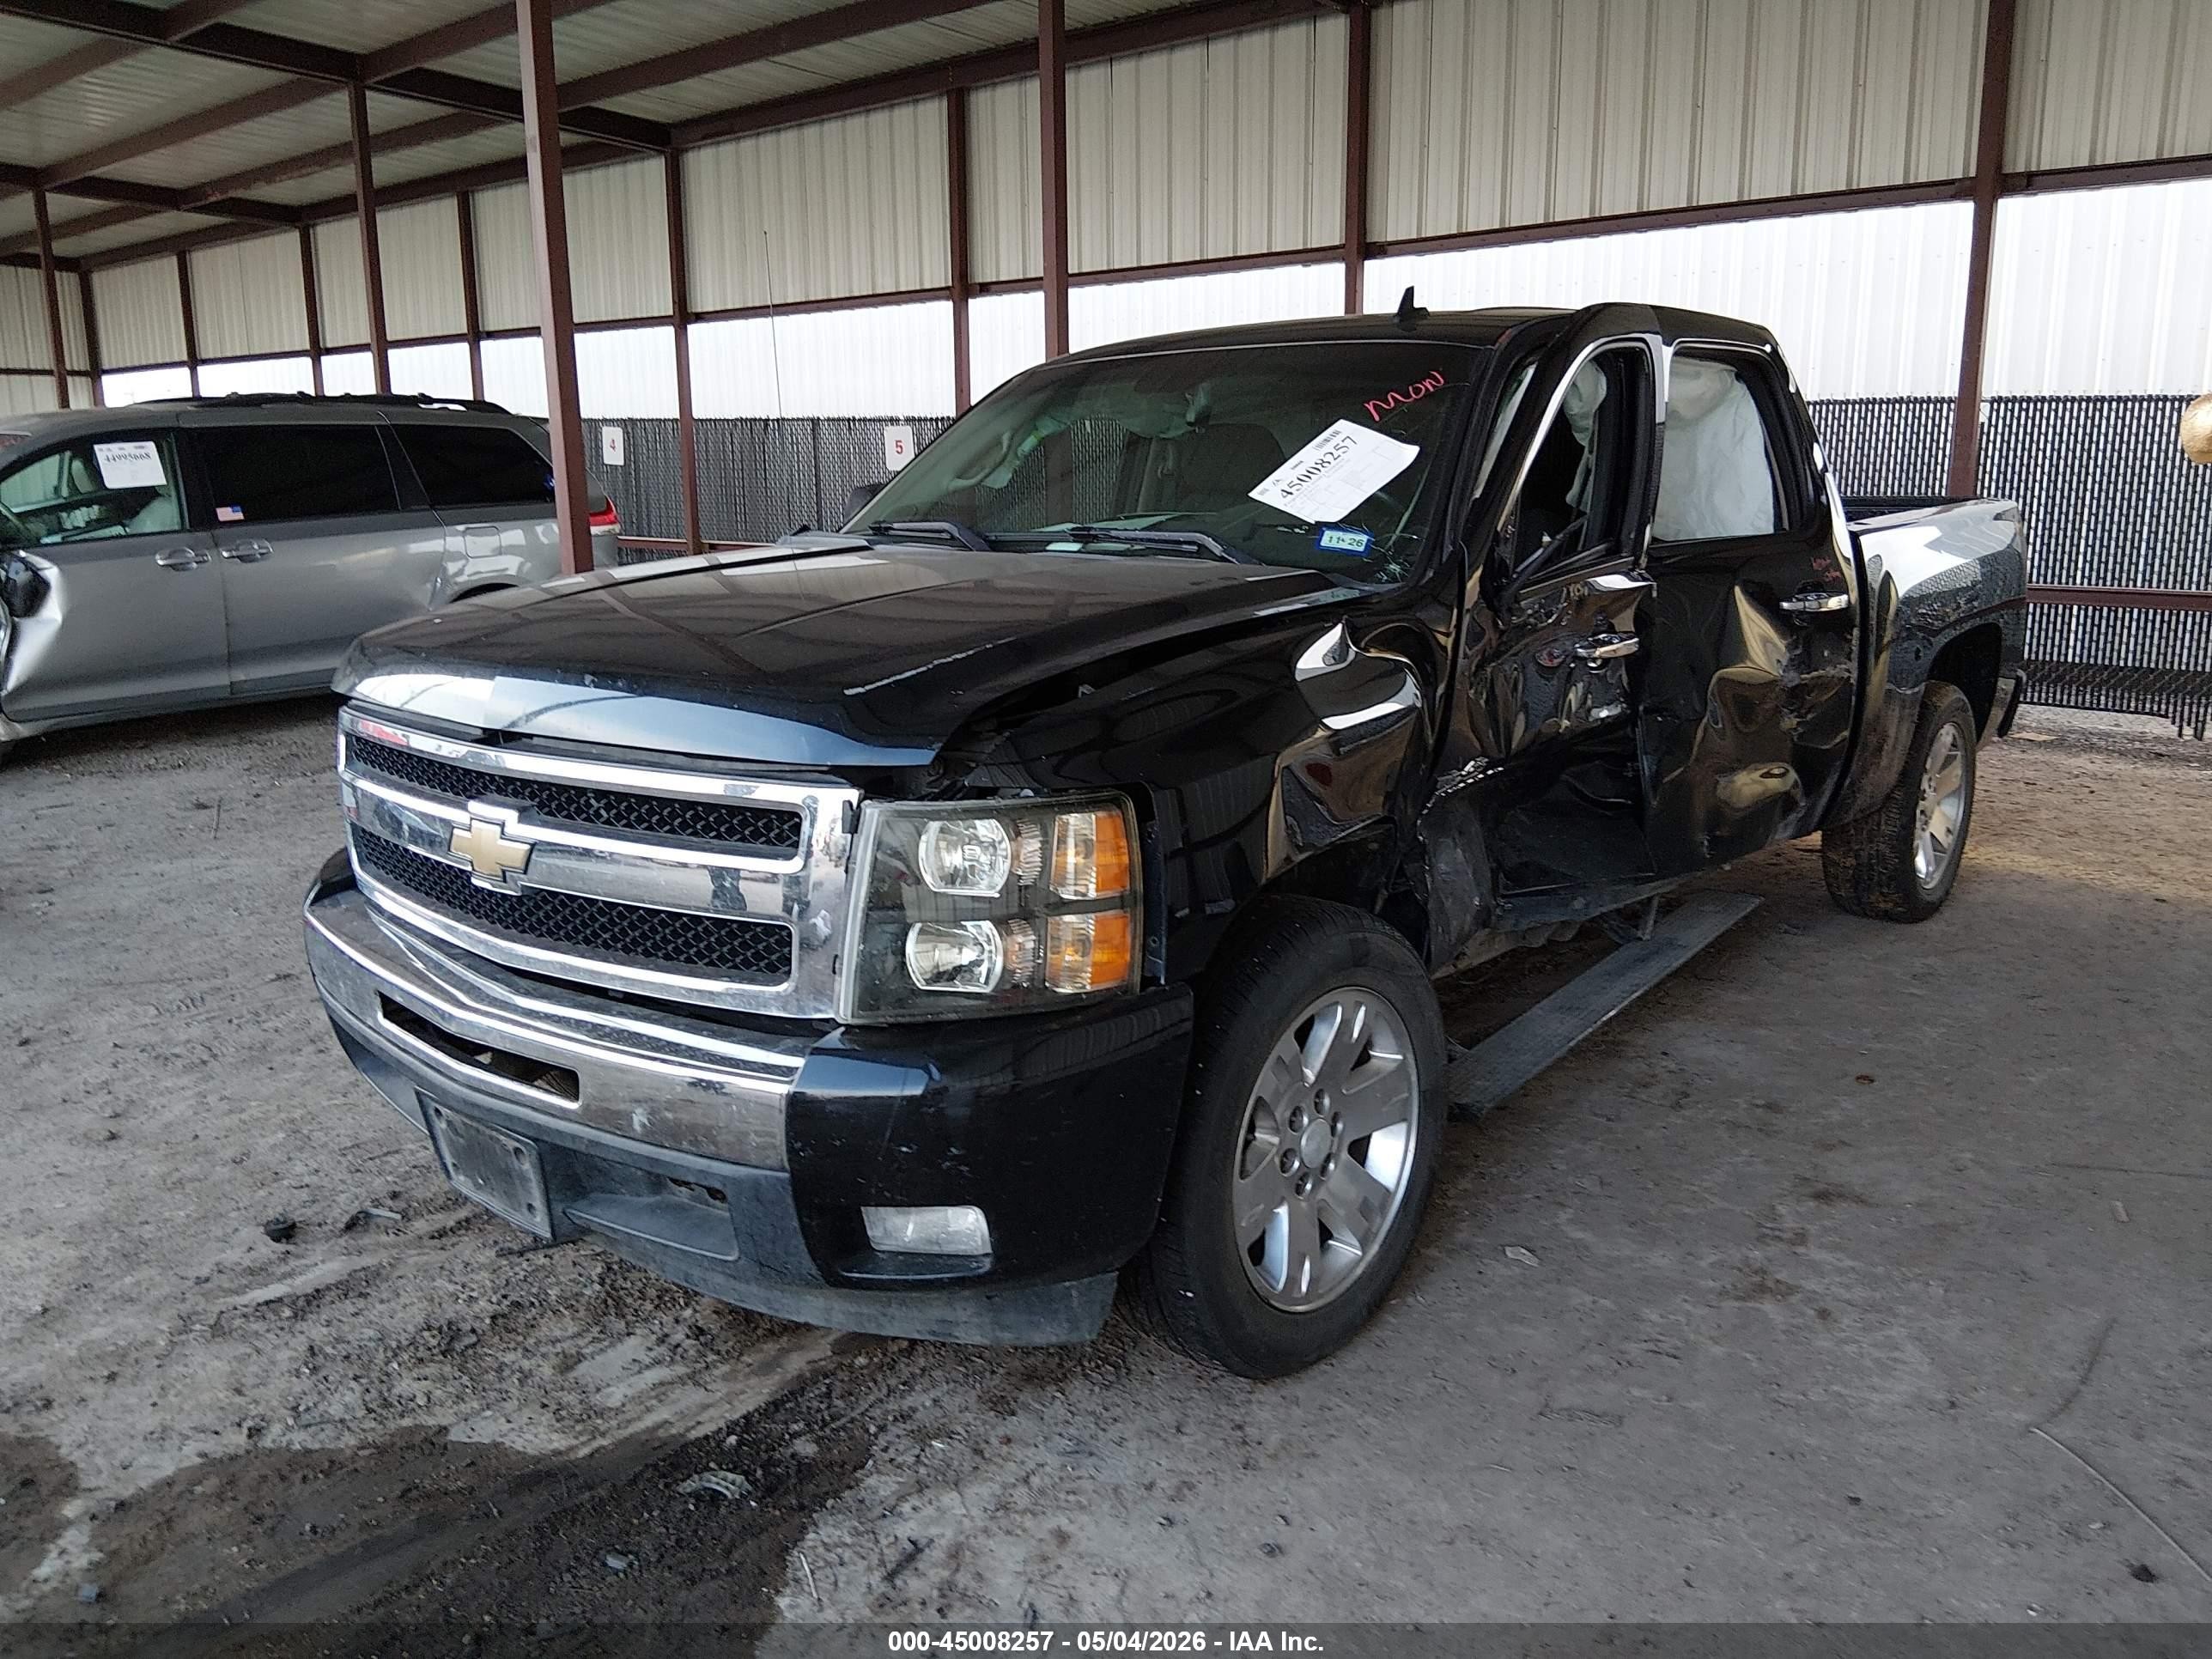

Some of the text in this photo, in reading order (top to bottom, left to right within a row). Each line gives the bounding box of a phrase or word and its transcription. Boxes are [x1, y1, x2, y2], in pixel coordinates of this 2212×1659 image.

[609, 438, 617, 453] 4
[894, 439, 904, 455] 5
[1279, 435, 1358, 499] 45008257
